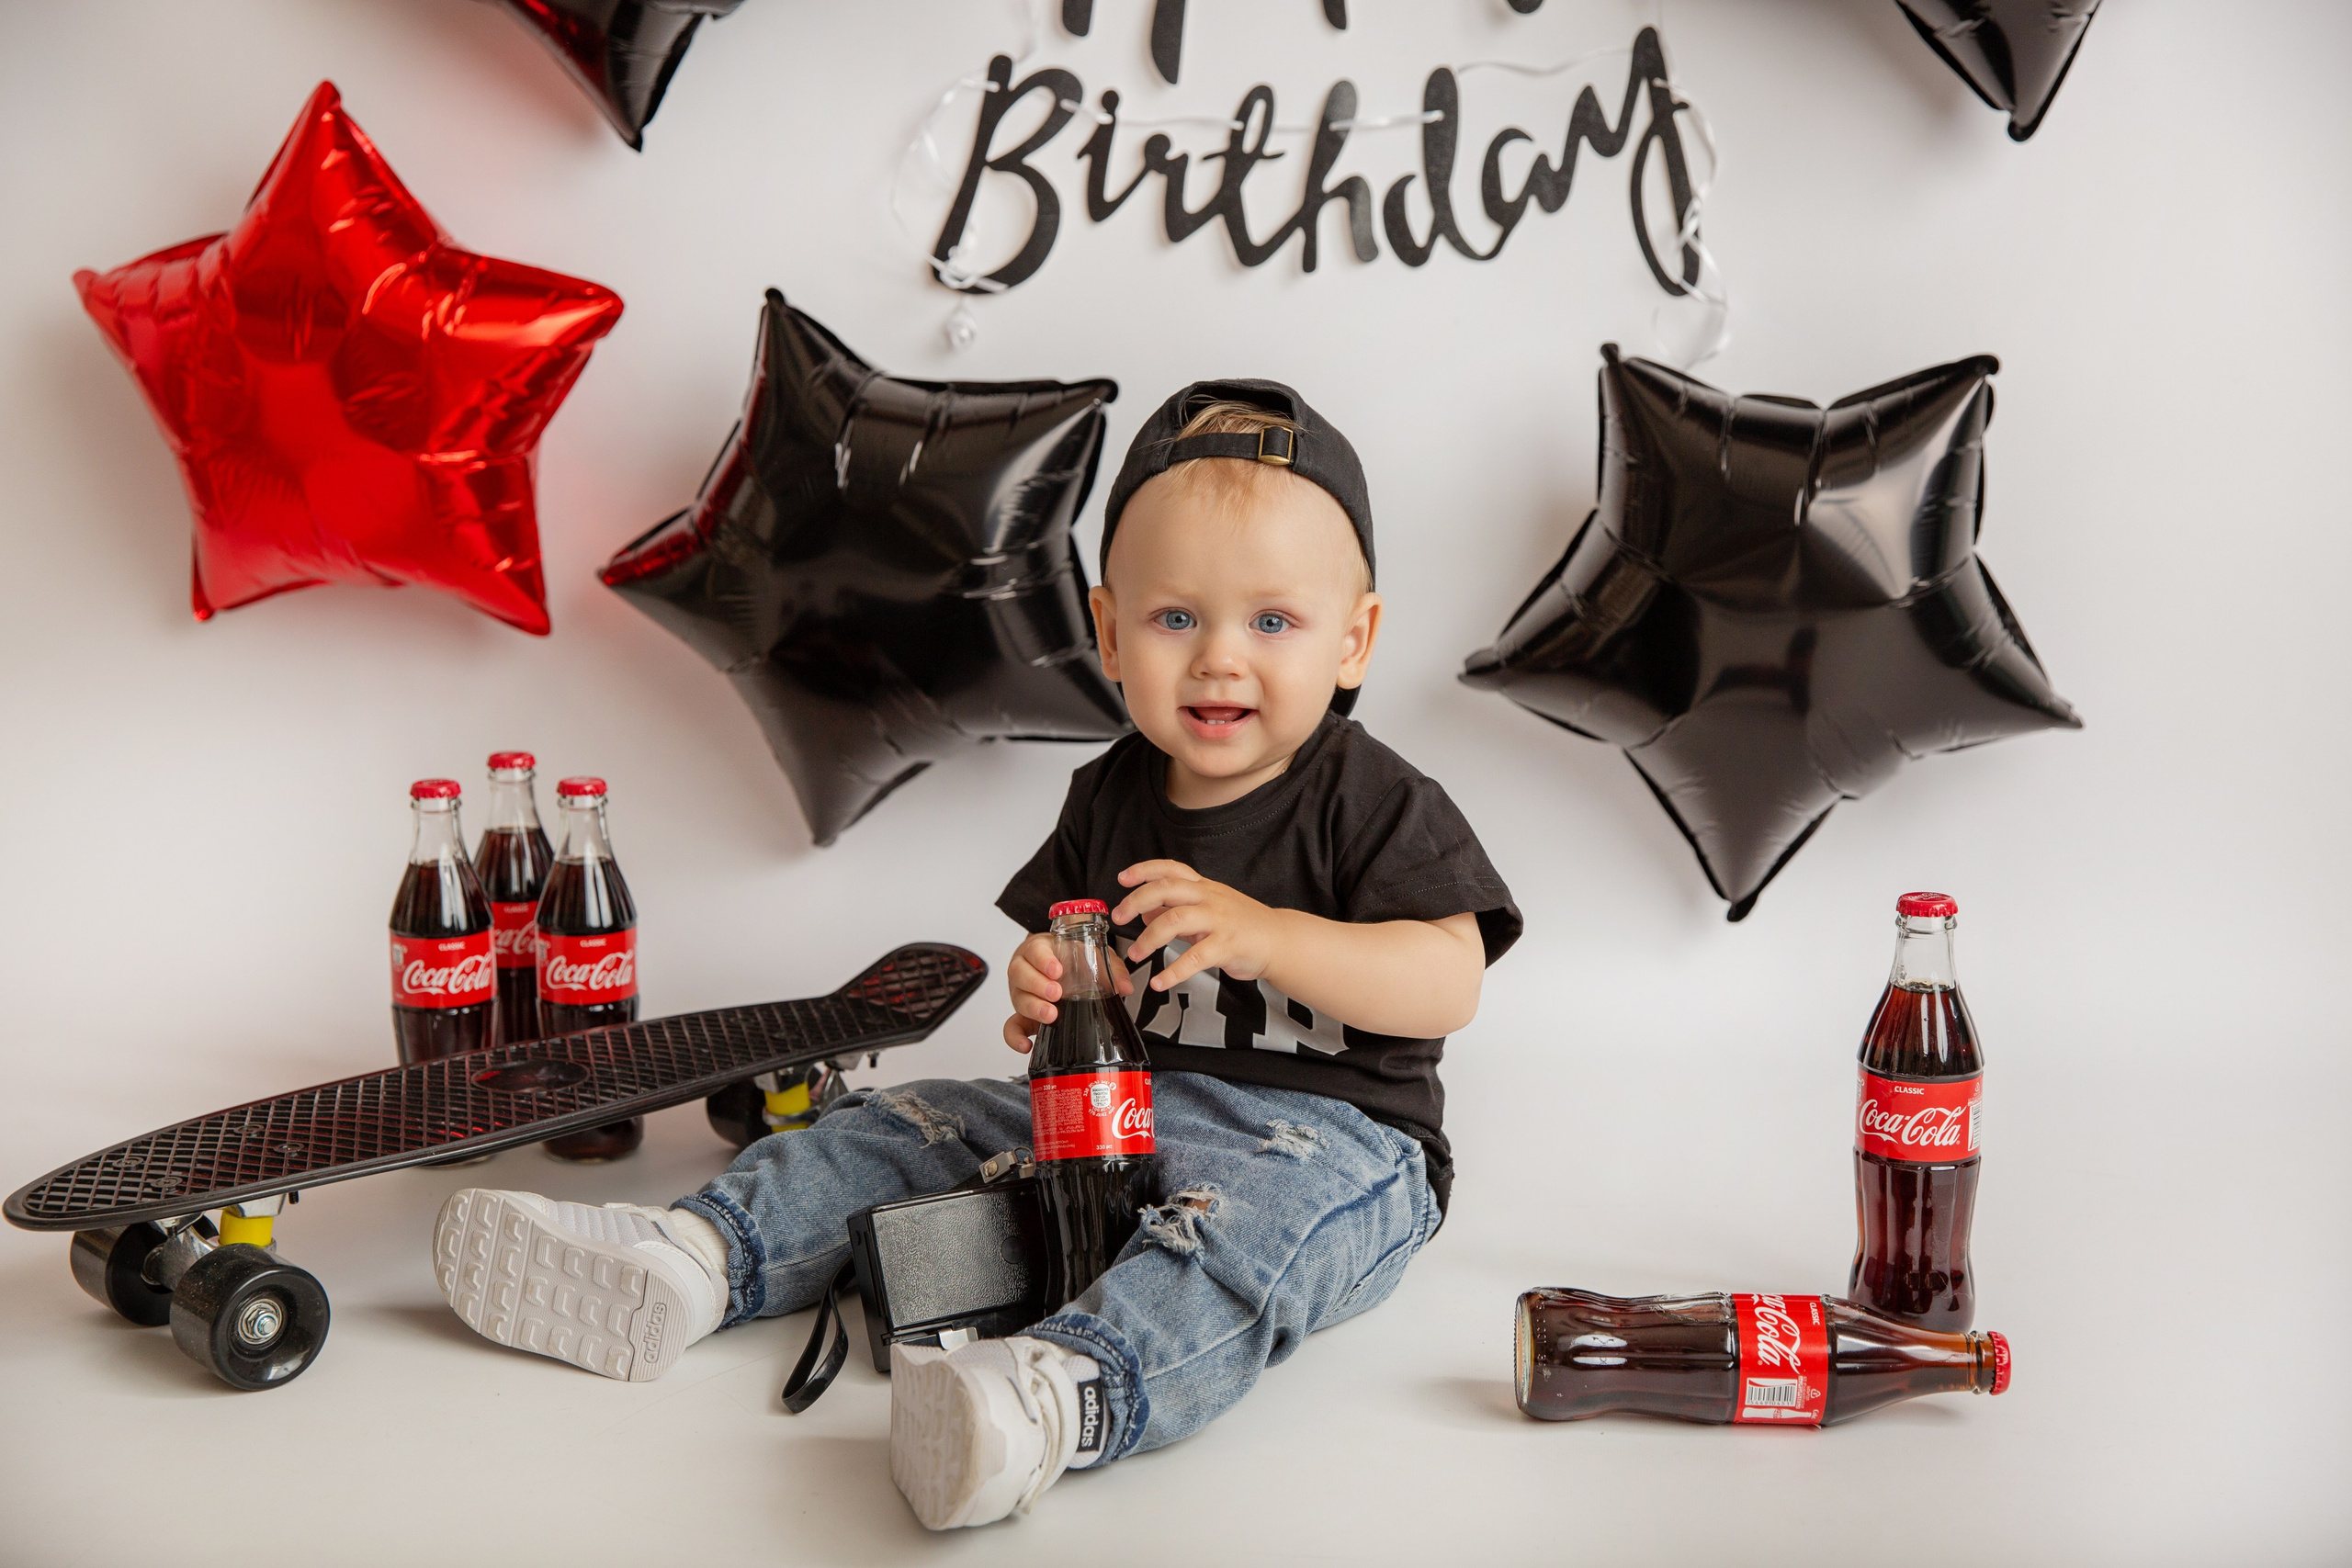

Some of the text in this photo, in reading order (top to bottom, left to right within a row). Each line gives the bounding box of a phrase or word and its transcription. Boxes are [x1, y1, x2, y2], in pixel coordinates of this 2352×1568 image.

[933, 26, 1702, 296] Birthday
[438, 941, 466, 952] CLASSIC
[580, 938, 607, 948] CLASSIC
[403, 952, 493, 995] Coca-Cola
[546, 952, 635, 991] Coca-Cola
[1894, 1086, 1925, 1096] CLASSIC
[1859, 1099, 1966, 1146] Coca-Cola
[643, 1302, 668, 1364] adidas
[1753, 1293, 1801, 1374] ca-Cola
[1809, 1302, 1820, 1325] CLASSIC
[1081, 1386, 1100, 1448] adidas
